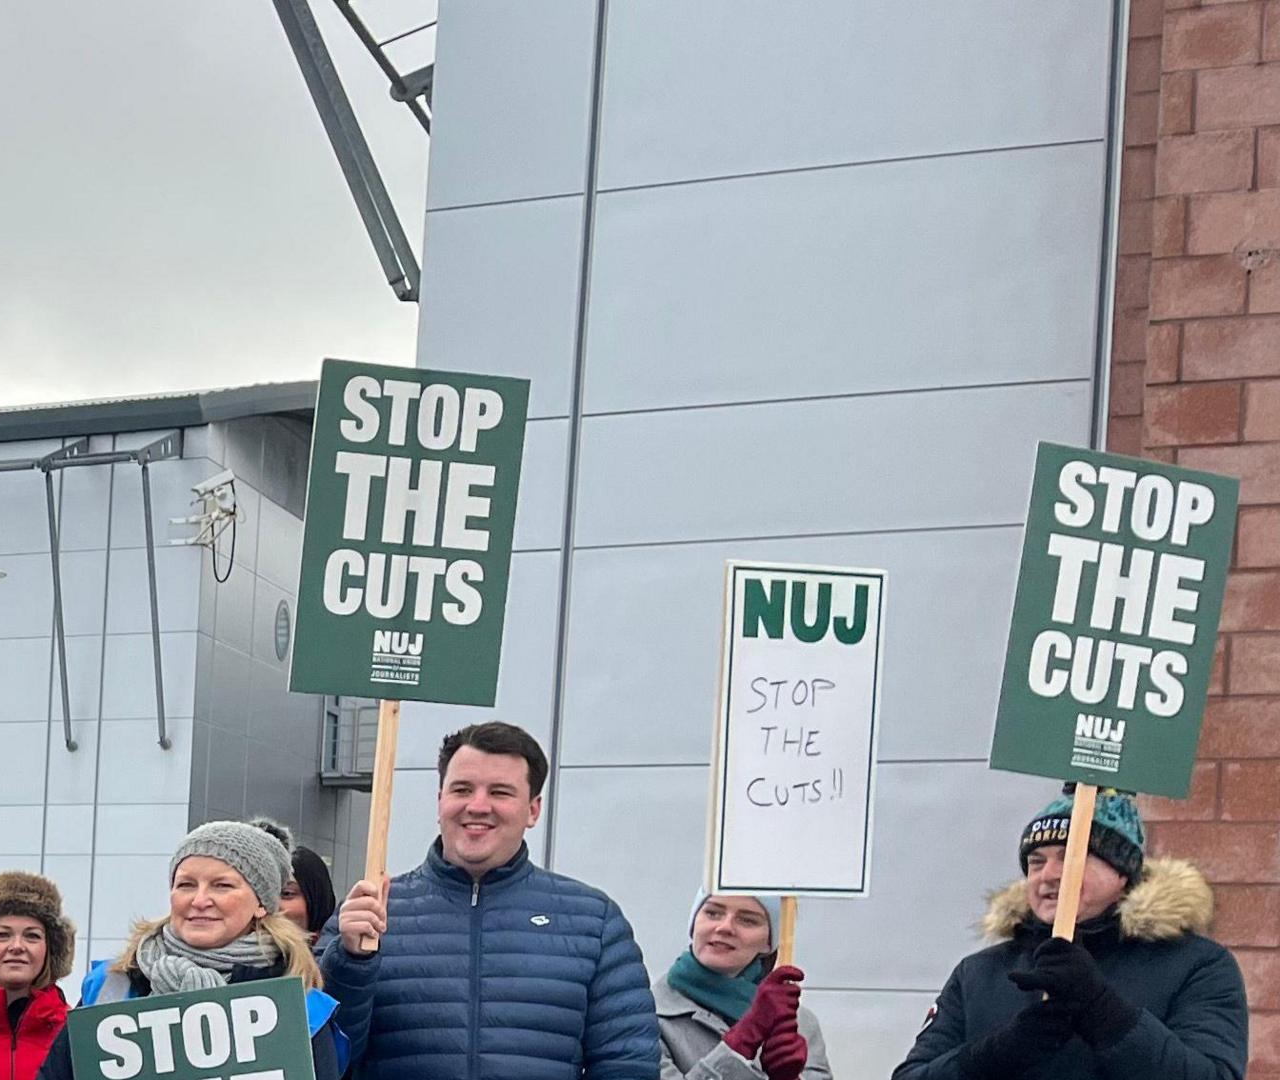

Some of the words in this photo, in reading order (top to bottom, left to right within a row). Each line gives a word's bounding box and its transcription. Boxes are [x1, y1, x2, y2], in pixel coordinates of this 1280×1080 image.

[340, 375, 504, 452] STOP
[335, 451, 496, 551] THE
[1054, 460, 1215, 546] STOP
[323, 548, 484, 626] CUTS
[742, 578, 869, 645] NUJ
[1048, 533, 1205, 646] THE
[373, 630, 424, 655] NUJ
[1028, 630, 1188, 718] CUTS
[746, 677, 836, 713] STOP
[1075, 713, 1126, 742] NUJ
[761, 726, 821, 756] THE
[1032, 818, 1070, 832] OUTE
[96, 995, 278, 1080] STOP
